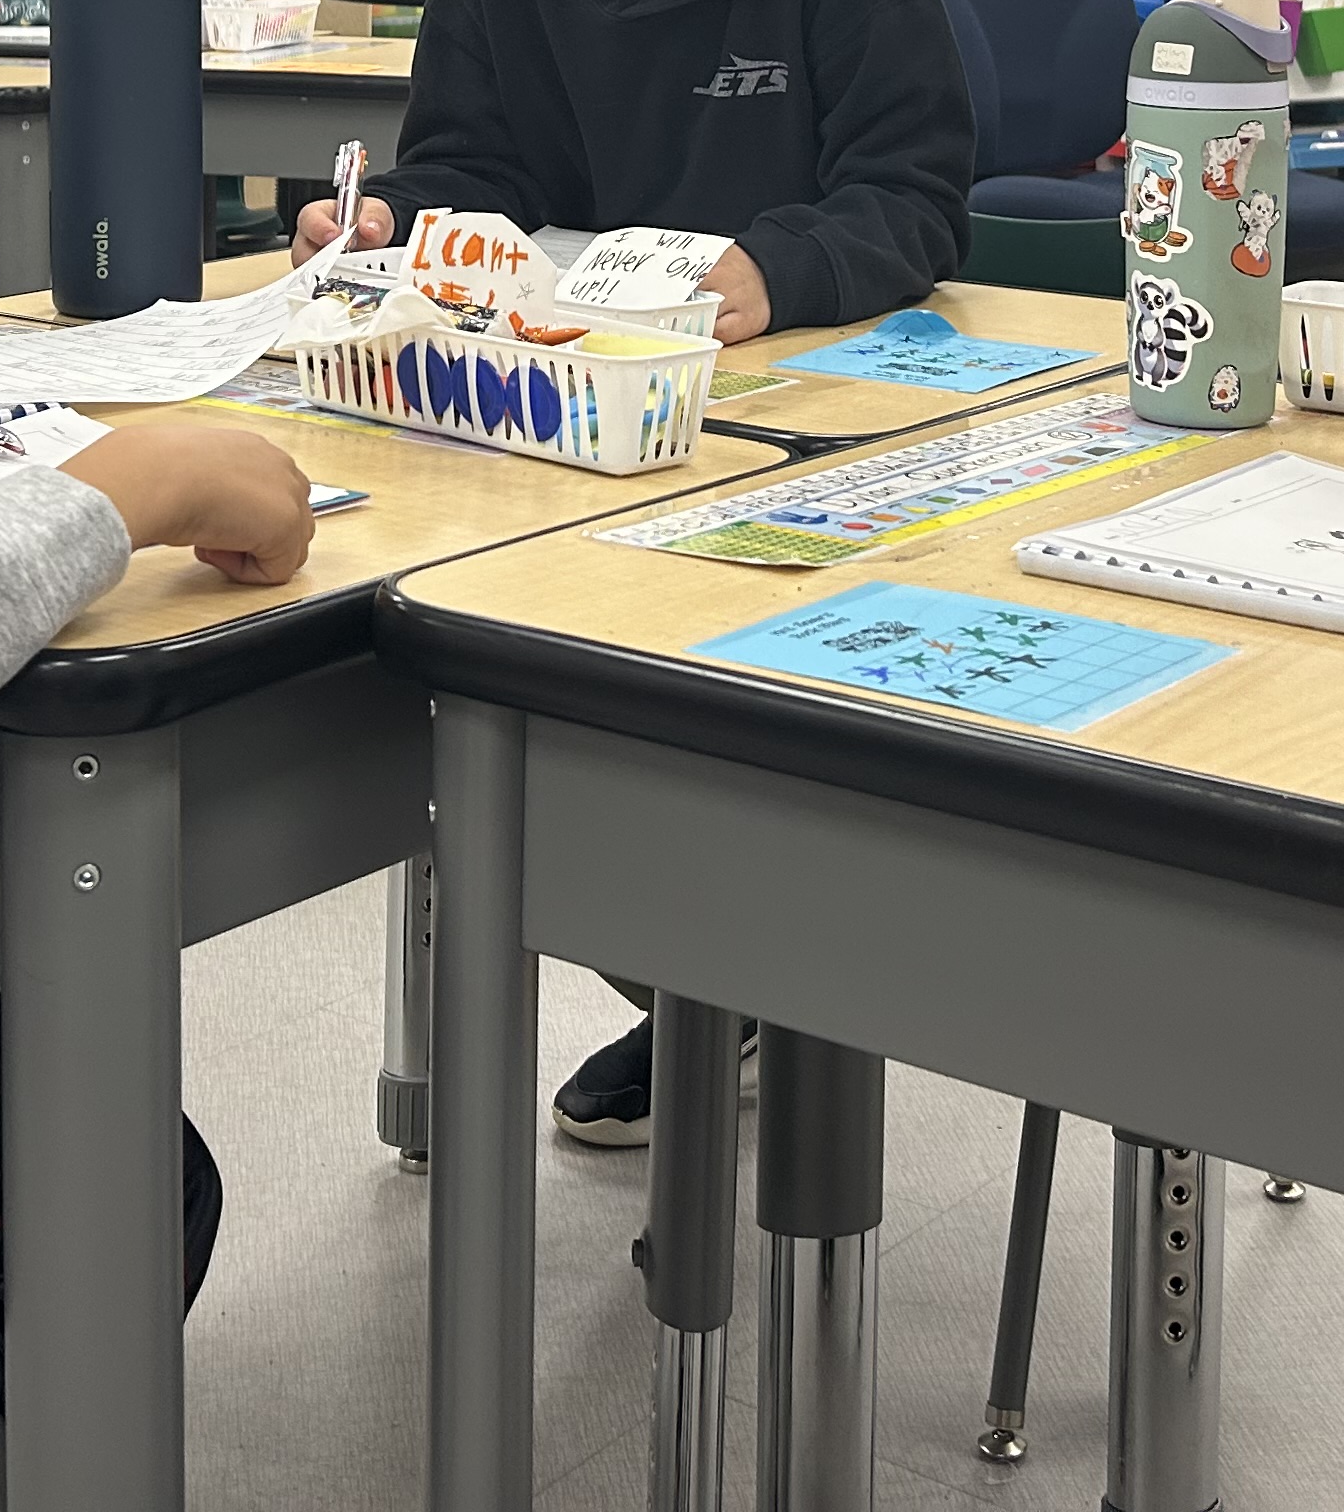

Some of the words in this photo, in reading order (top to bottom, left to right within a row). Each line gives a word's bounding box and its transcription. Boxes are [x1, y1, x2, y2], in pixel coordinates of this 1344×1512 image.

[92, 221, 109, 280] owala
[412, 214, 438, 271] I
[615, 231, 634, 243] I
